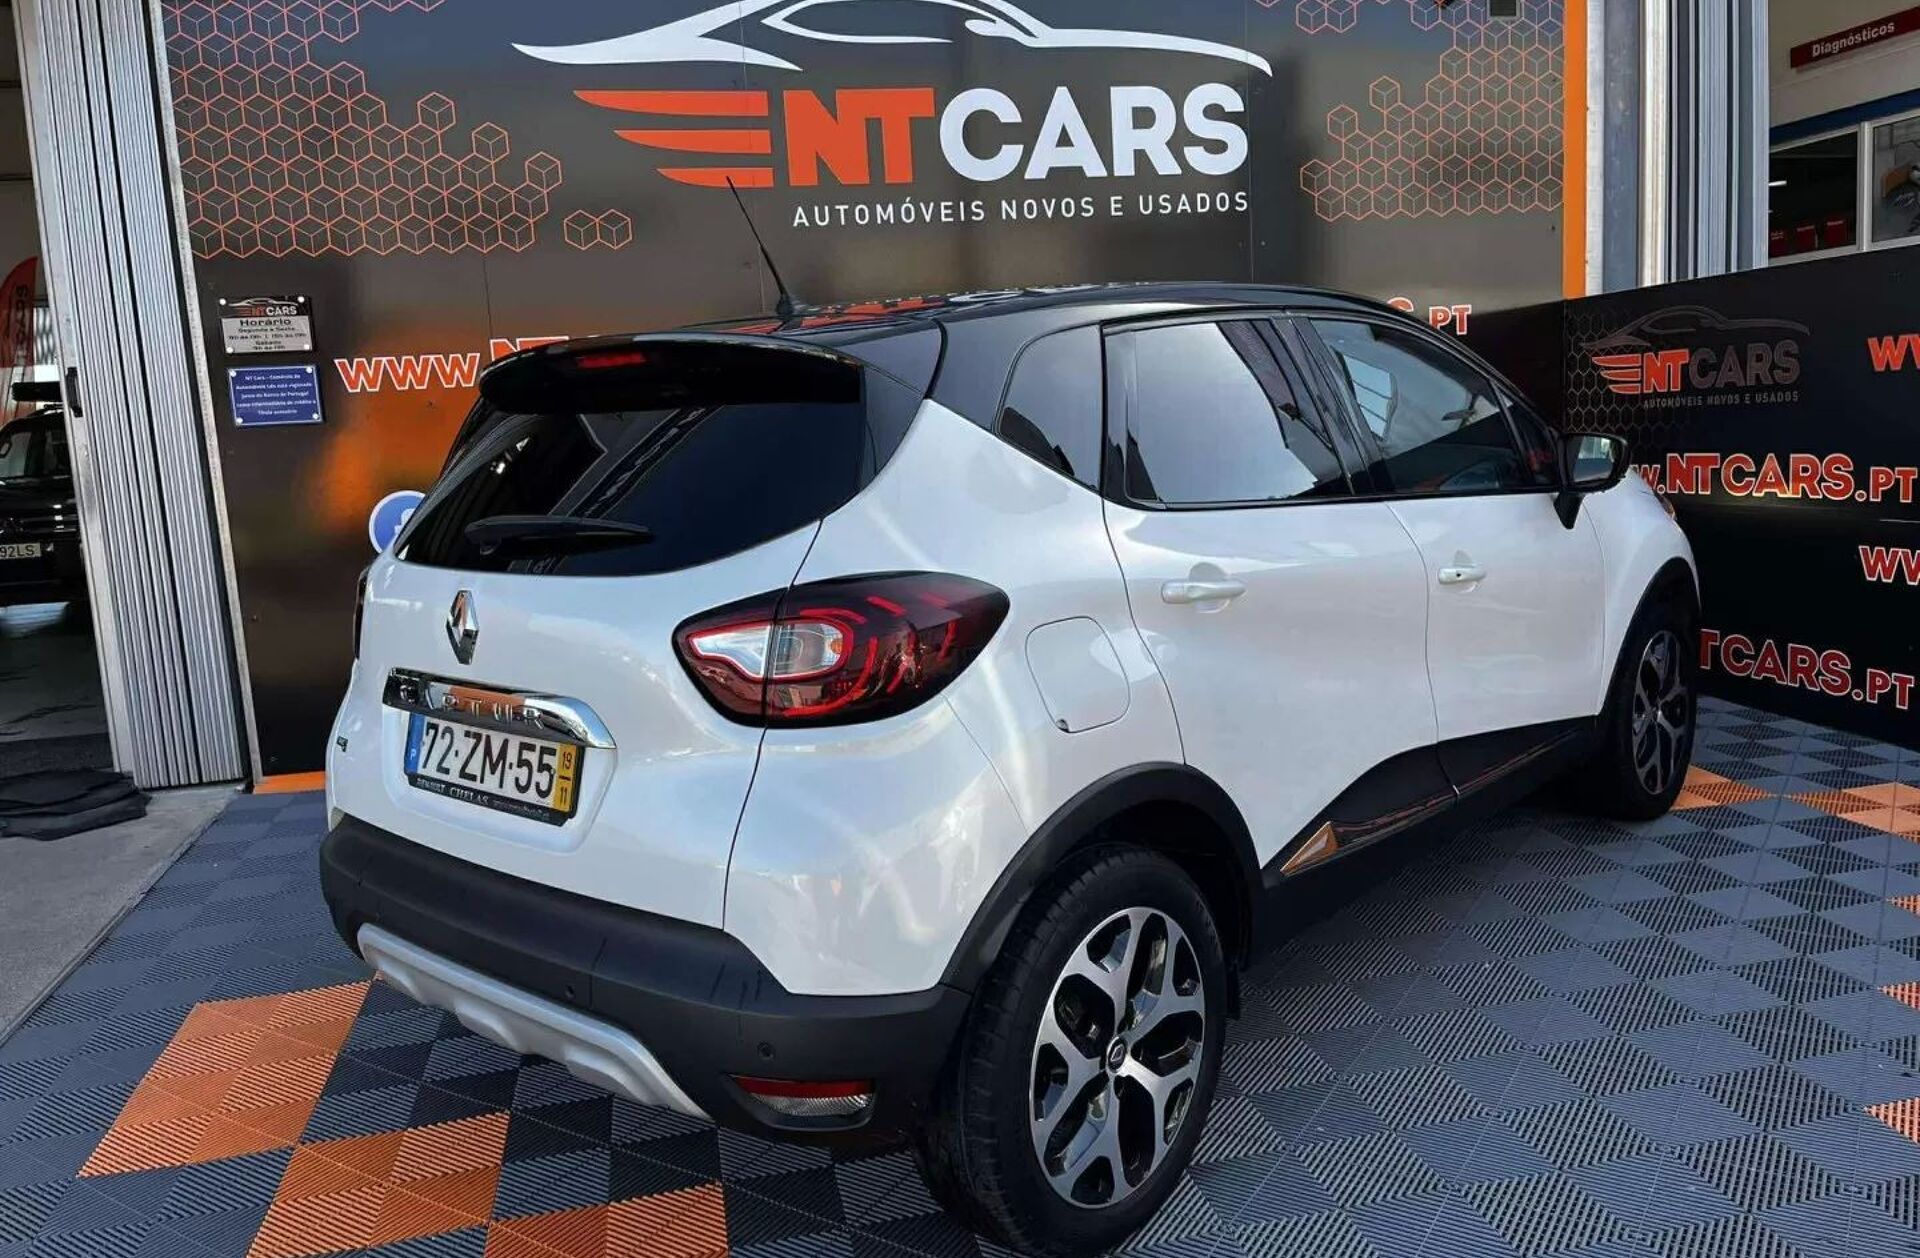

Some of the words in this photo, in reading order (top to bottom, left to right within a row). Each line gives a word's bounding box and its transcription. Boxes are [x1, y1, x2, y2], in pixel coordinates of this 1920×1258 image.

[1812, 22, 1895, 57] Diagnósticos
[792, 197, 985, 227] AUTOMÓVEIS
[1001, 196, 1094, 220] NOVOS
[1110, 196, 1123, 216] E
[1139, 192, 1248, 215] USADOS
[240, 318, 291, 326] Horário
[1643, 396, 1703, 409] AUTOMÓVEIS
[1707, 393, 1740, 405] NOVOS
[1744, 393, 1751, 402] E
[1755, 391, 1799, 403] USADOS
[562, 751, 572, 769] 19
[559, 786, 569, 804] 11
